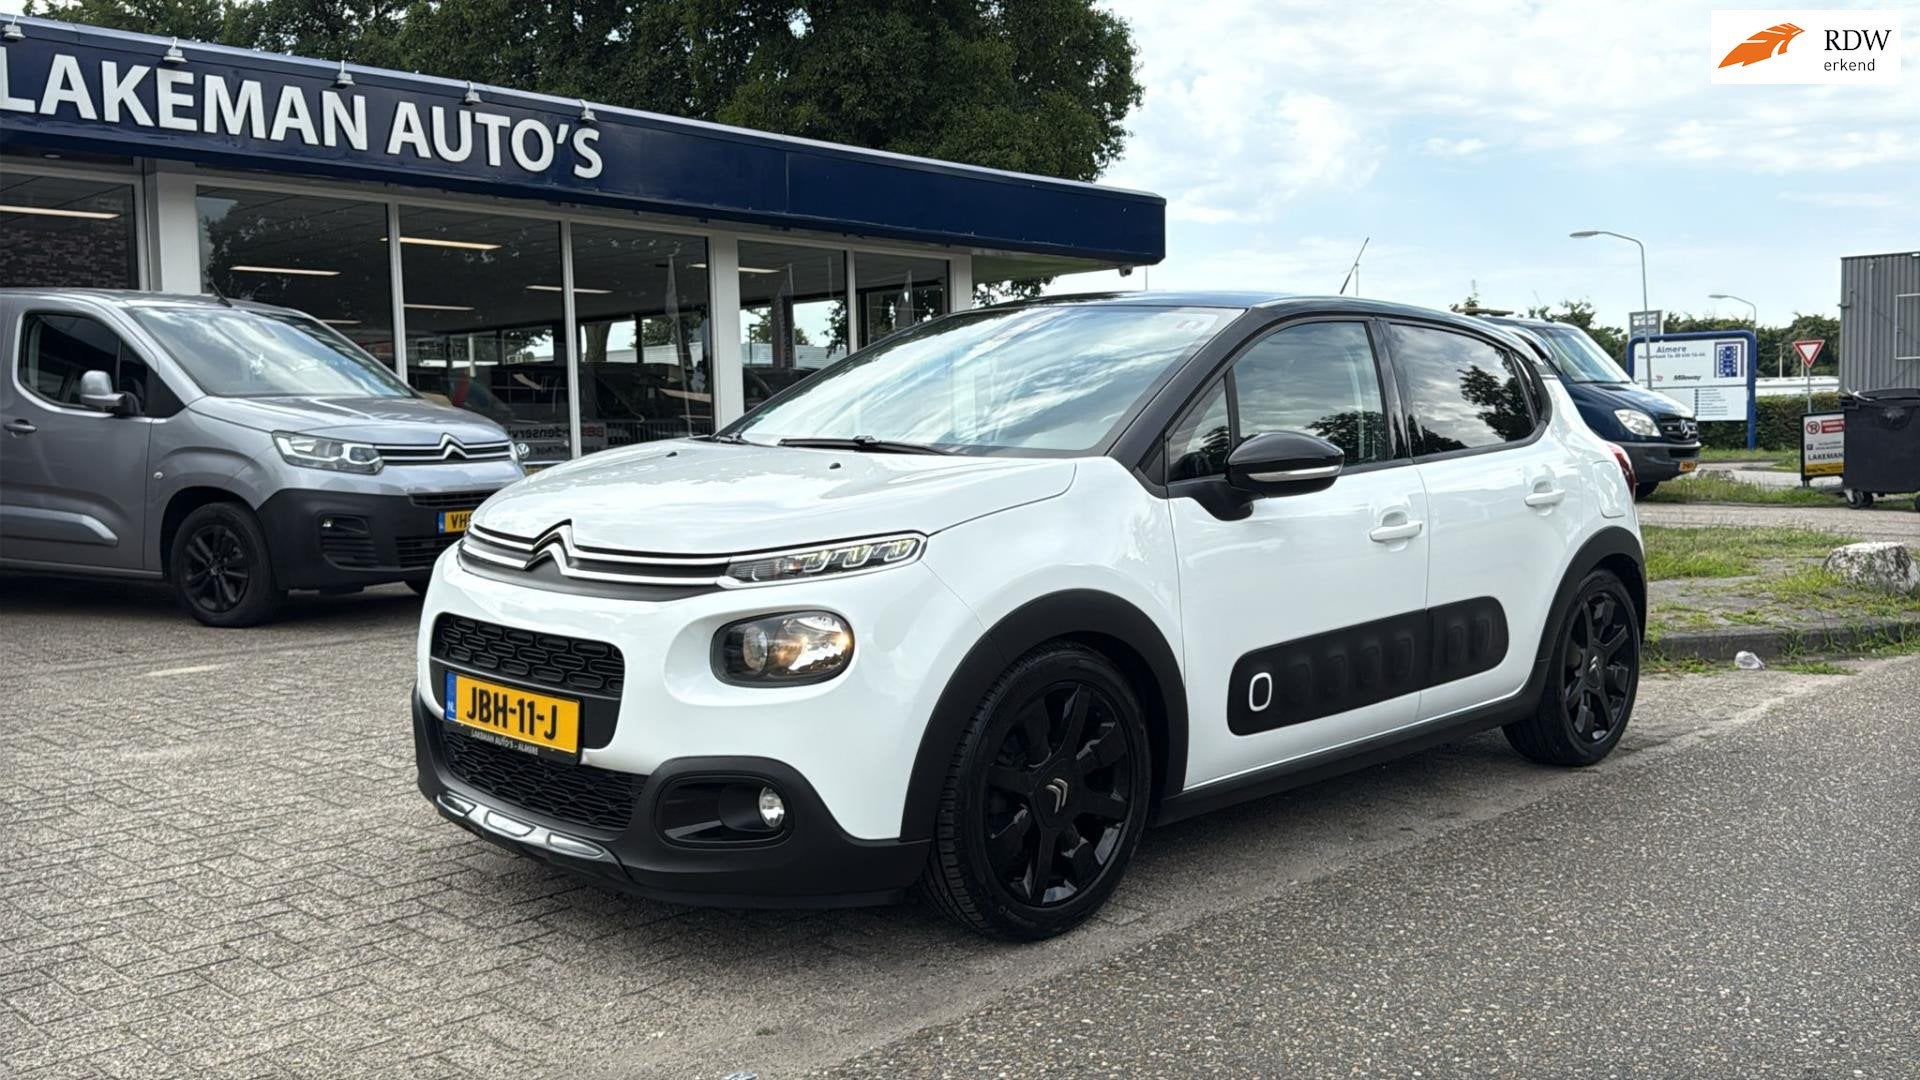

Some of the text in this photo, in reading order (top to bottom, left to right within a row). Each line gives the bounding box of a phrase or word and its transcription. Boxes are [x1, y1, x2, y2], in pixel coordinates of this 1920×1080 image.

[0, 46, 604, 180] LAKEMAN AUTO'S
[1656, 345, 1687, 354] Almere
[451, 513, 471, 529] VH
[466, 686, 558, 741] JBH-11-J
